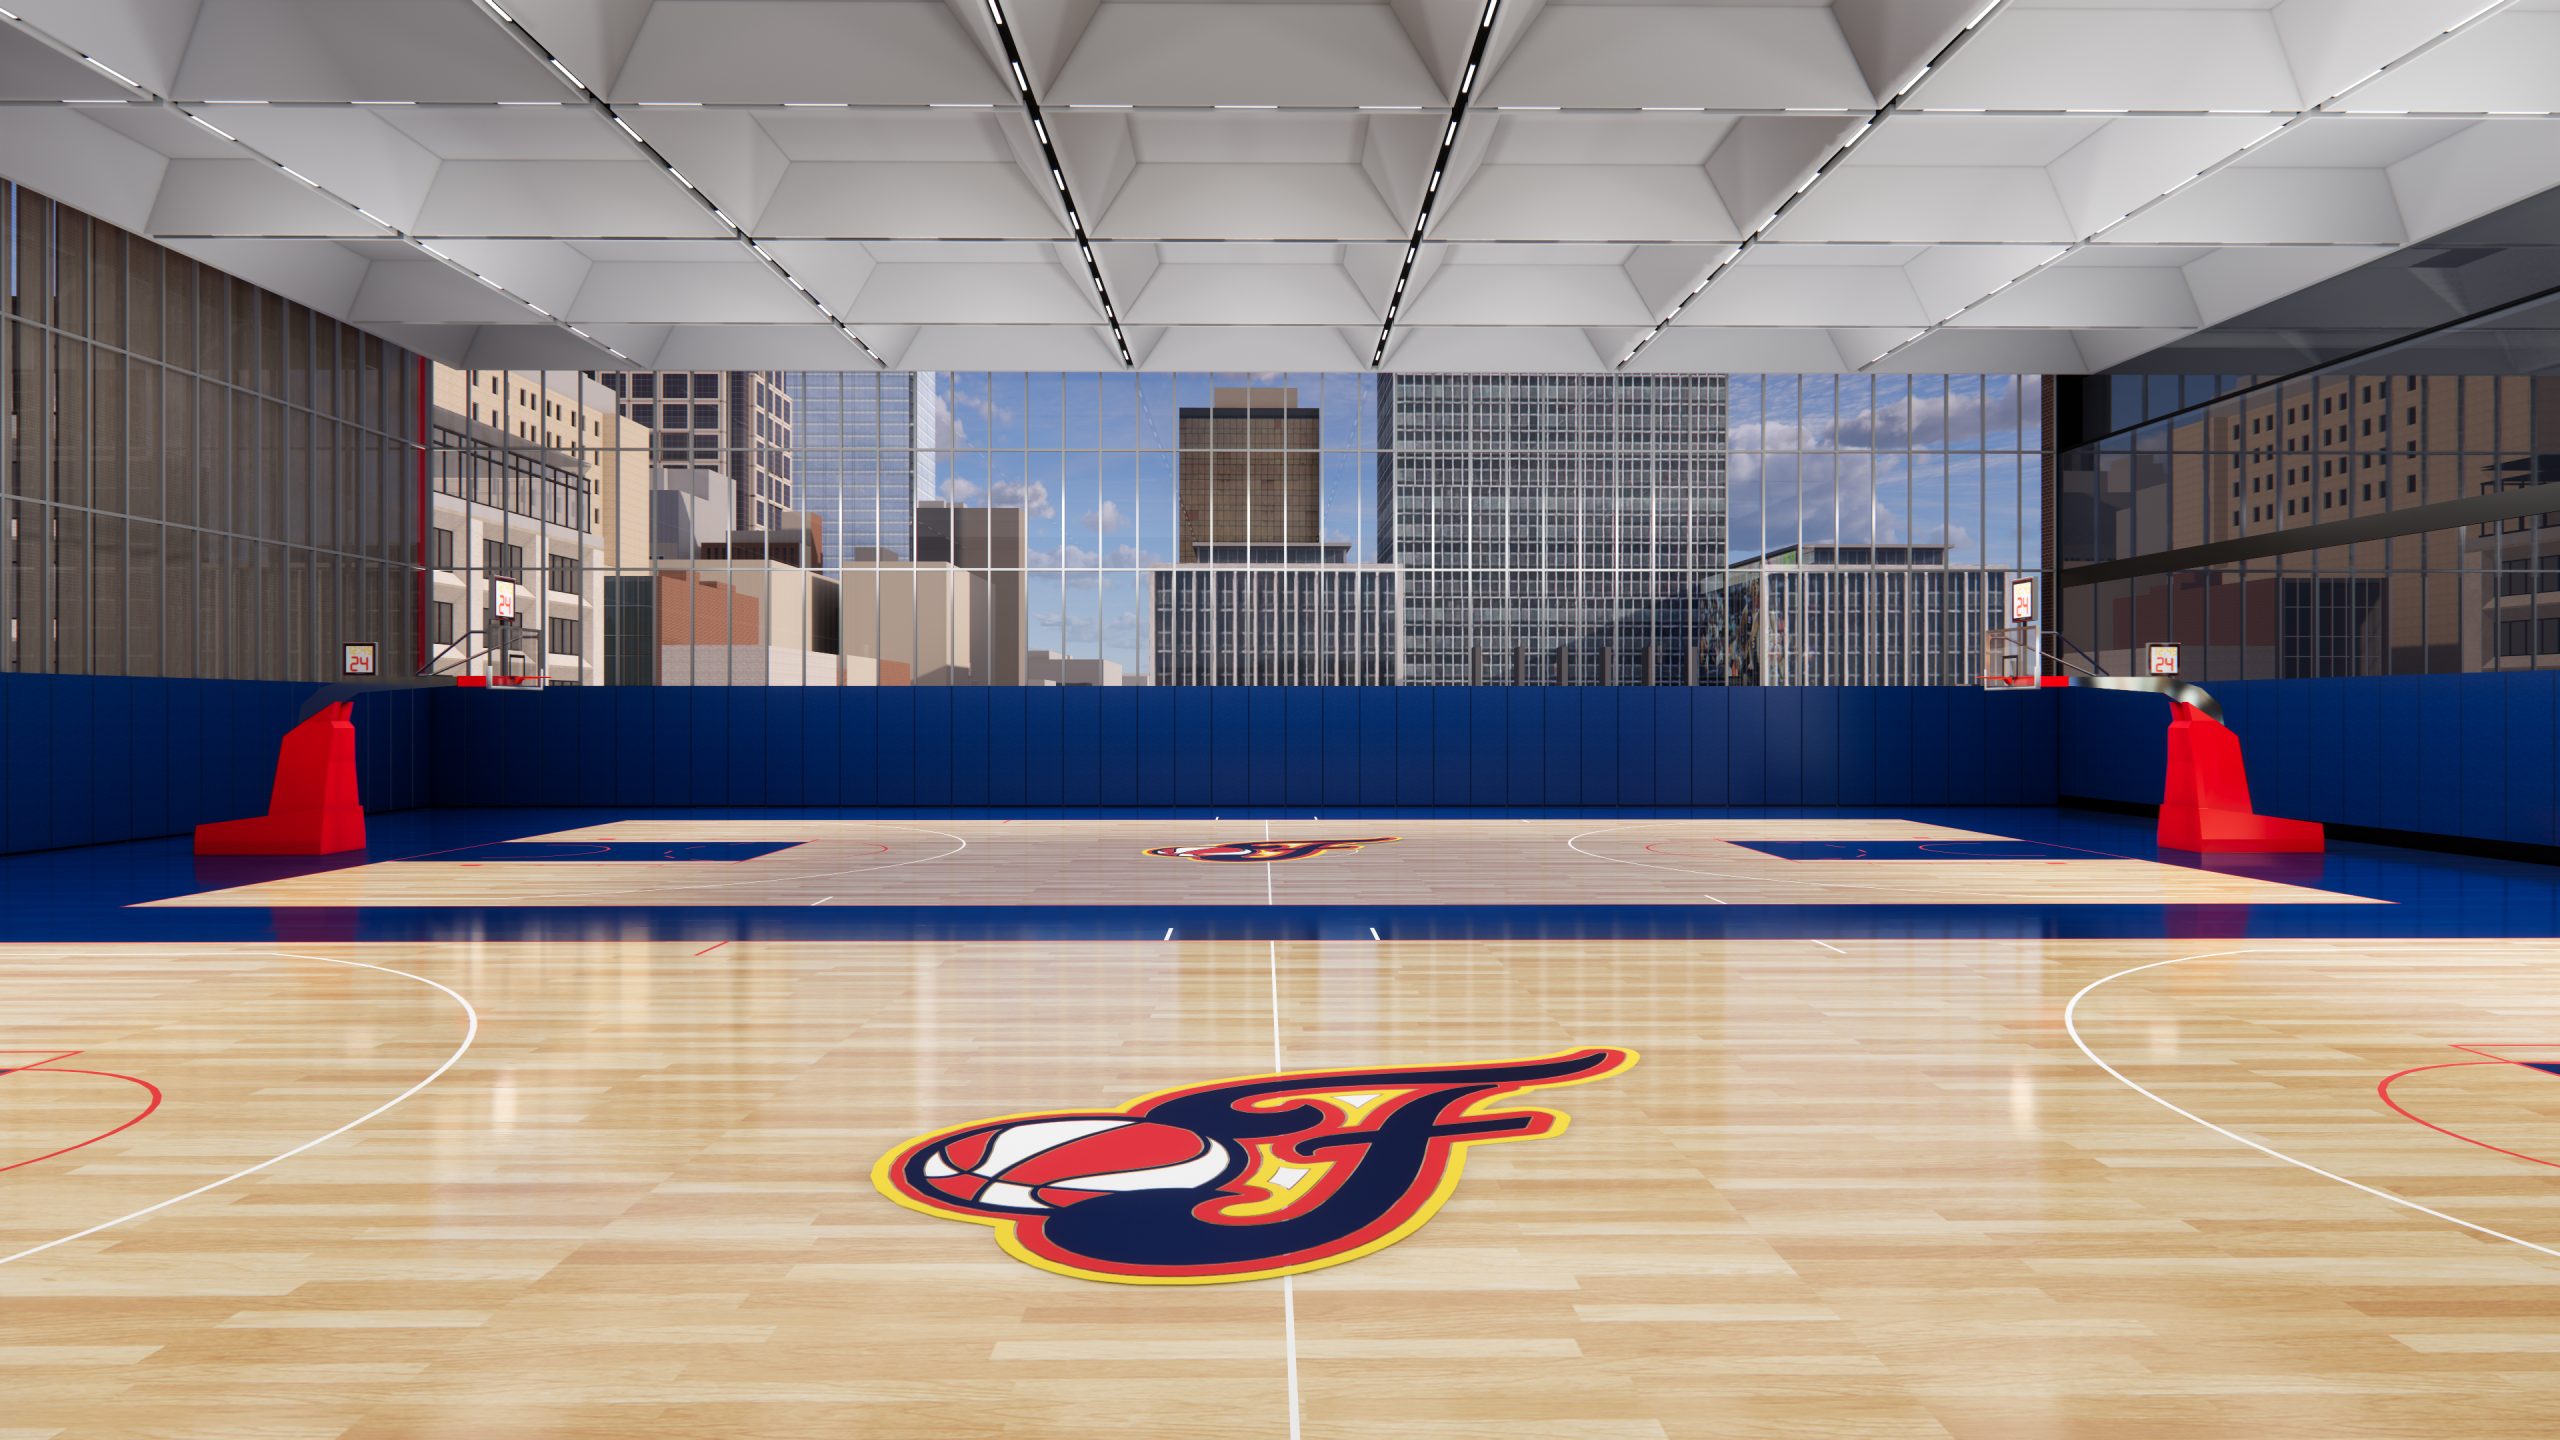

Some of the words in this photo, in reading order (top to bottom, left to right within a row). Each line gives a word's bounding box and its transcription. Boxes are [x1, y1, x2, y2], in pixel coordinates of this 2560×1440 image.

[499, 595, 512, 615] 24
[2016, 597, 2029, 616] 24
[350, 656, 369, 672] 24
[2155, 657, 2174, 672] 24
